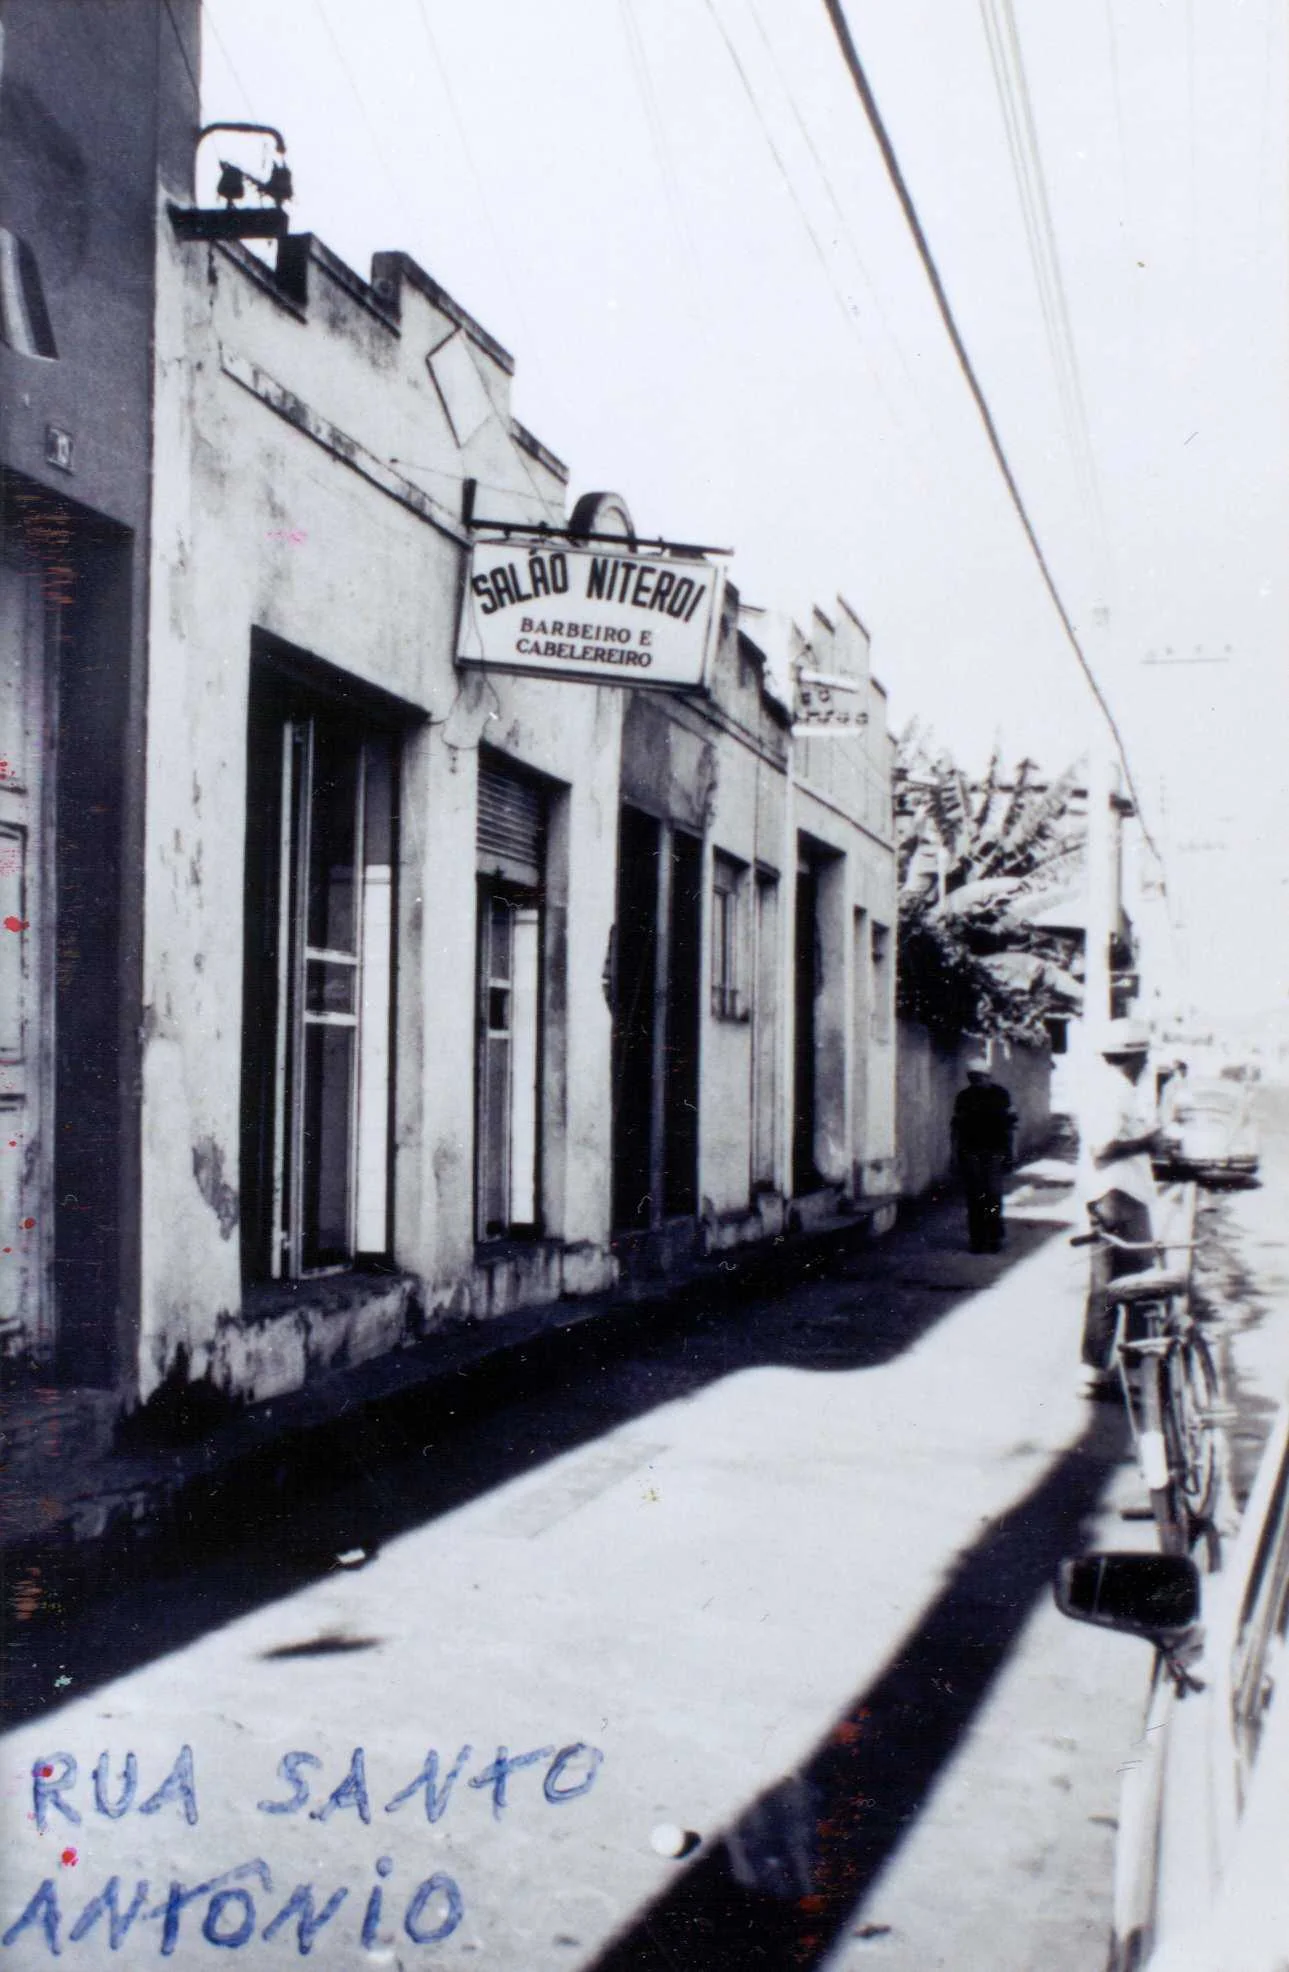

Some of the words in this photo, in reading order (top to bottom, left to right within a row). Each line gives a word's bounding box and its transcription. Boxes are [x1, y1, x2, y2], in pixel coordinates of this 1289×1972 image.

[586, 557, 705, 622] NITEROI
[520, 617, 631, 643] BARBEIRO
[640, 630, 652, 646] E
[515, 639, 652, 668] CABELEREIRO
